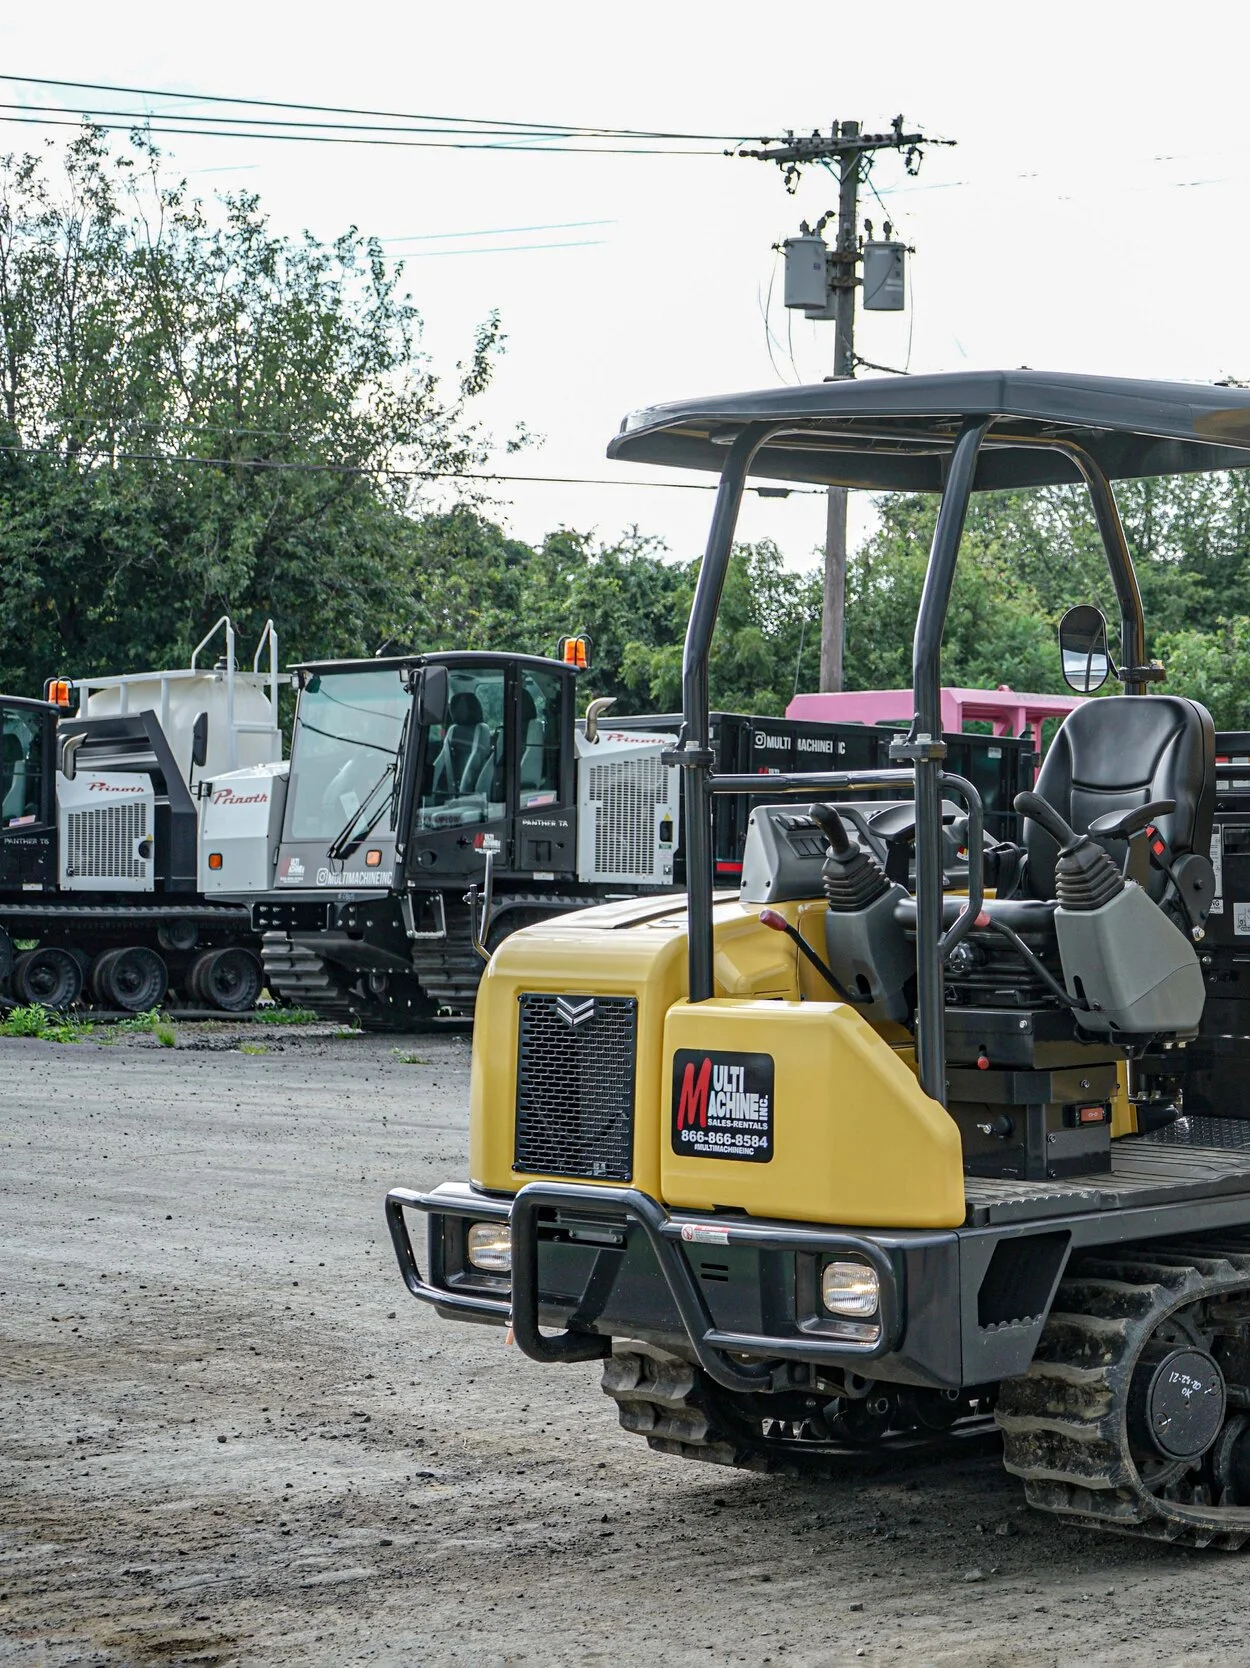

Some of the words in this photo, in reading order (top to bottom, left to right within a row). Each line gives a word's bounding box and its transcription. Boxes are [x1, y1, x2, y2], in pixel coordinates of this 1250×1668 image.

[86, 782, 144, 792] Prinoth
[213, 788, 268, 805] Prinoth
[522, 819, 556, 827] PANTHER
[759, 1095, 768, 1120] INC.
[707, 1118, 768, 1130] SALES-RENTALS
[681, 1130, 768, 1148] 866-866-8584
[694, 1144, 755, 1155] #MULTIMACHINEINC
